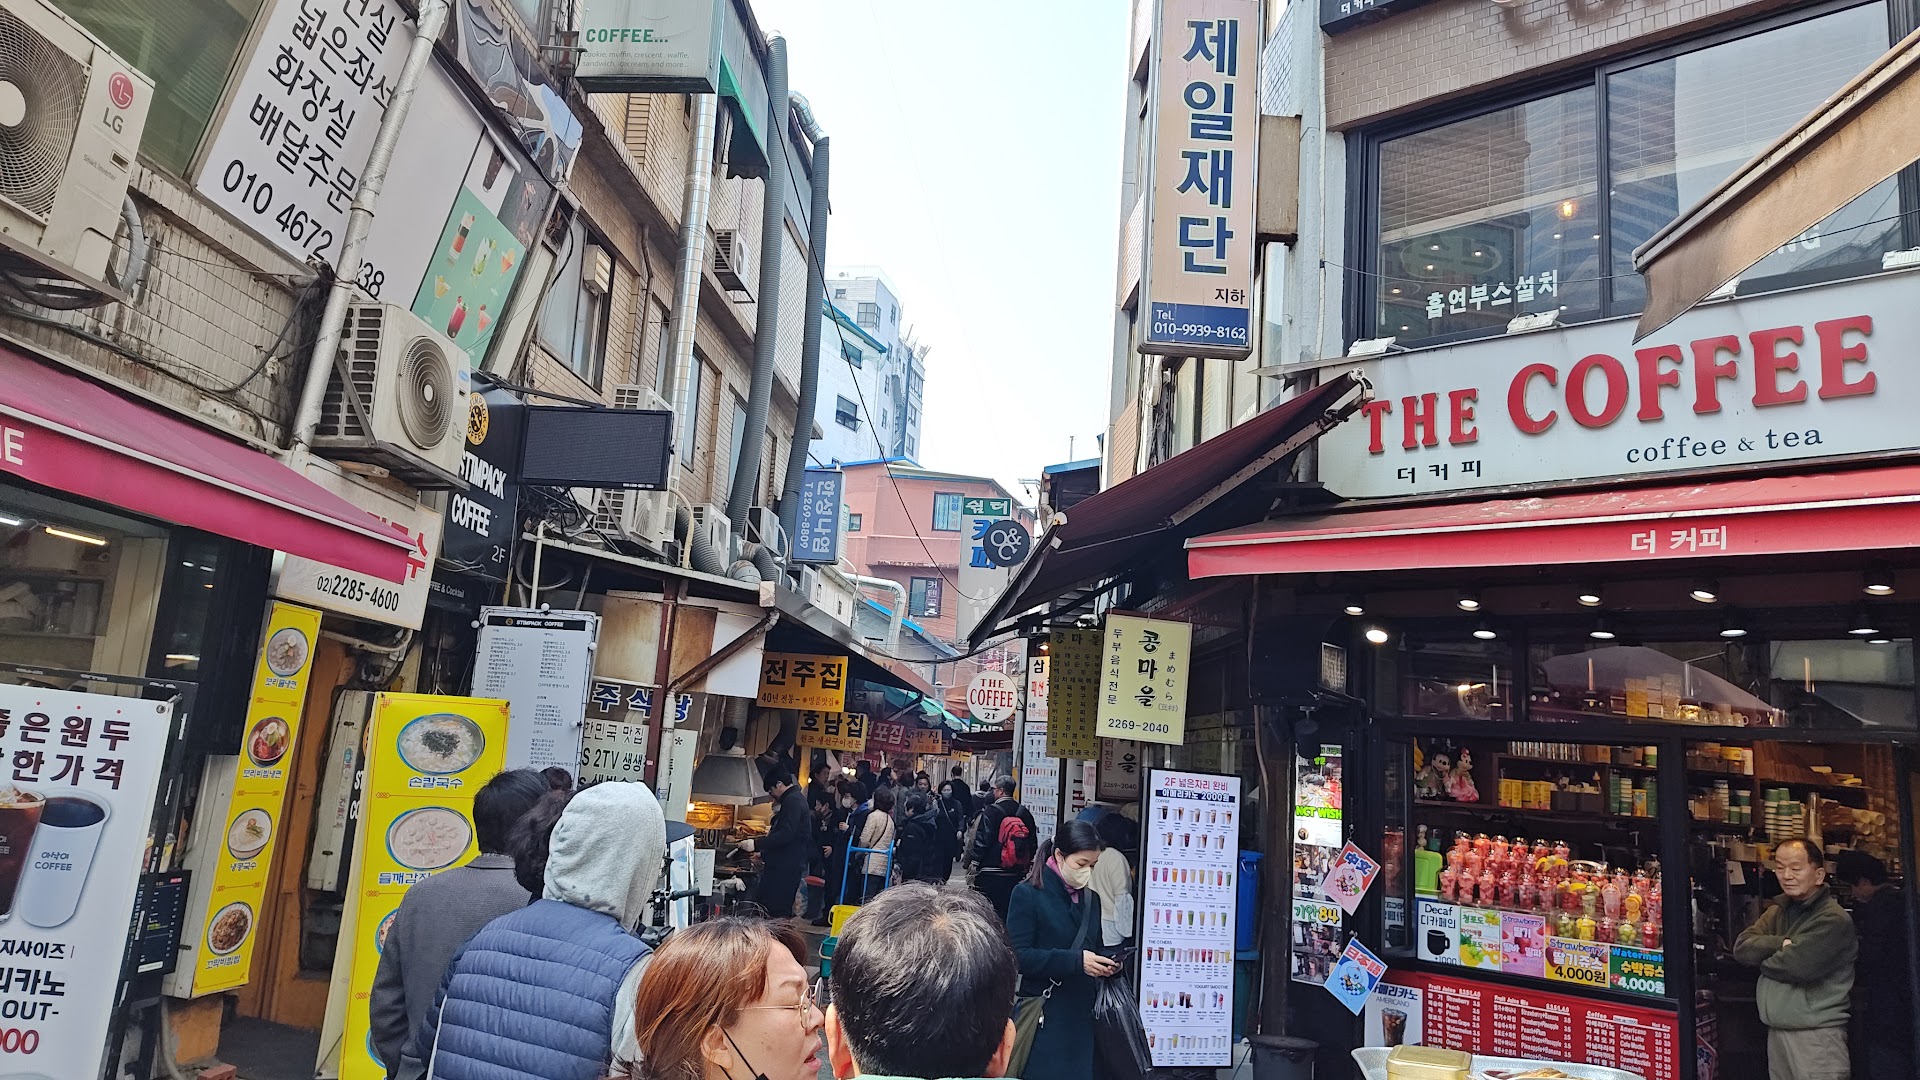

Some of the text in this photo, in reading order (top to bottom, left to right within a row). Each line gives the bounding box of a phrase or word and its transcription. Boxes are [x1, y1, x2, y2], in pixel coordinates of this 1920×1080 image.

[609, 50, 633, 58] muffin,
[582, 60, 616, 68] sandwich,
[619, 60, 650, 68] icecream,
[268, 44, 355, 148] 화장실
[103, 107, 124, 134] LG
[249, 93, 356, 214] 배달주문
[1175, 18, 1239, 277] 제일재단
[223, 159, 272, 214] 010
[276, 202, 333, 261] 4672
[1214, 288, 1245, 305] 지하
[1426, 269, 1559, 320] 흡연부스설치
[1156, 309, 1174, 320] Tel.
[1153, 322, 1246, 341] 010-9939-8162
[1362, 314, 1878, 455] THE COFFEE
[1627, 425, 1824, 463] coffee & tea
[451, 496, 492, 538] COFFEE
[800, 491, 813, 549] 2269-8809
[1631, 525, 1728, 555] 더 커피
[492, 545, 506, 563] 2F
[765, 659, 843, 690] 전주집
[1107, 628, 1123, 705] 두부음식전문
[1135, 629, 1161, 707] 콩마을
[980, 678, 1004, 688] THE
[1165, 651, 1176, 701] まめむら
[762, 692, 778, 703] 40년
[970, 688, 1014, 707] COFFEE
[800, 710, 864, 738] 호남집
[984, 712, 998, 720] 2F
[1108, 718, 1169, 734] 2269-2040
[622, 725, 644, 745] 맛집
[800, 735, 815, 743] 원조
[593, 748, 620, 770] 2TV
[622, 752, 647, 772] 생생
[0, 747, 125, 790] 한가격
[408, 776, 464, 789] 손칼국수
[1164, 777, 1176, 786] 2F
[1213, 781, 1228, 791] 완비
[1162, 788, 1230, 802] 아메리카노 2000원
[1295, 805, 1342, 819] NCT WISH
[34, 861, 72, 871] COFFEE
[229, 861, 257, 873] 냉콩국수
[1344, 850, 1374, 876] 中文
[1294, 904, 1339, 924] 기안84
[1425, 903, 1453, 916] Decaf
[1420, 914, 1456, 929] 디카페인
[1462, 914, 1484, 925] 청포도
[1502, 914, 1544, 927] Strawberry
[1513, 926, 1532, 938] 딸기
[1549, 939, 1605, 957] Strawberry
[1344, 946, 1383, 977] 日本語
[1555, 966, 1606, 984] 4,000원
[1428, 983, 1441, 991] Fruit
[1618, 976, 1665, 994] 4,000원
[1376, 997, 1409, 1007] AMERICANO
[1446, 995, 1470, 1005] Strawberry
[1446, 1003, 1460, 1011] Peach
[1586, 1010, 1607, 1020] Coffee
[1446, 1025, 1472, 1035] Watermelon
[1446, 1032, 1462, 1040] Tomato
[1620, 1025, 1647, 1035] Americano
[1446, 1039, 1462, 1047] Orange
[1620, 1048, 1635, 1057] Vanilla
[1636, 1051, 1649, 1059] Latte
